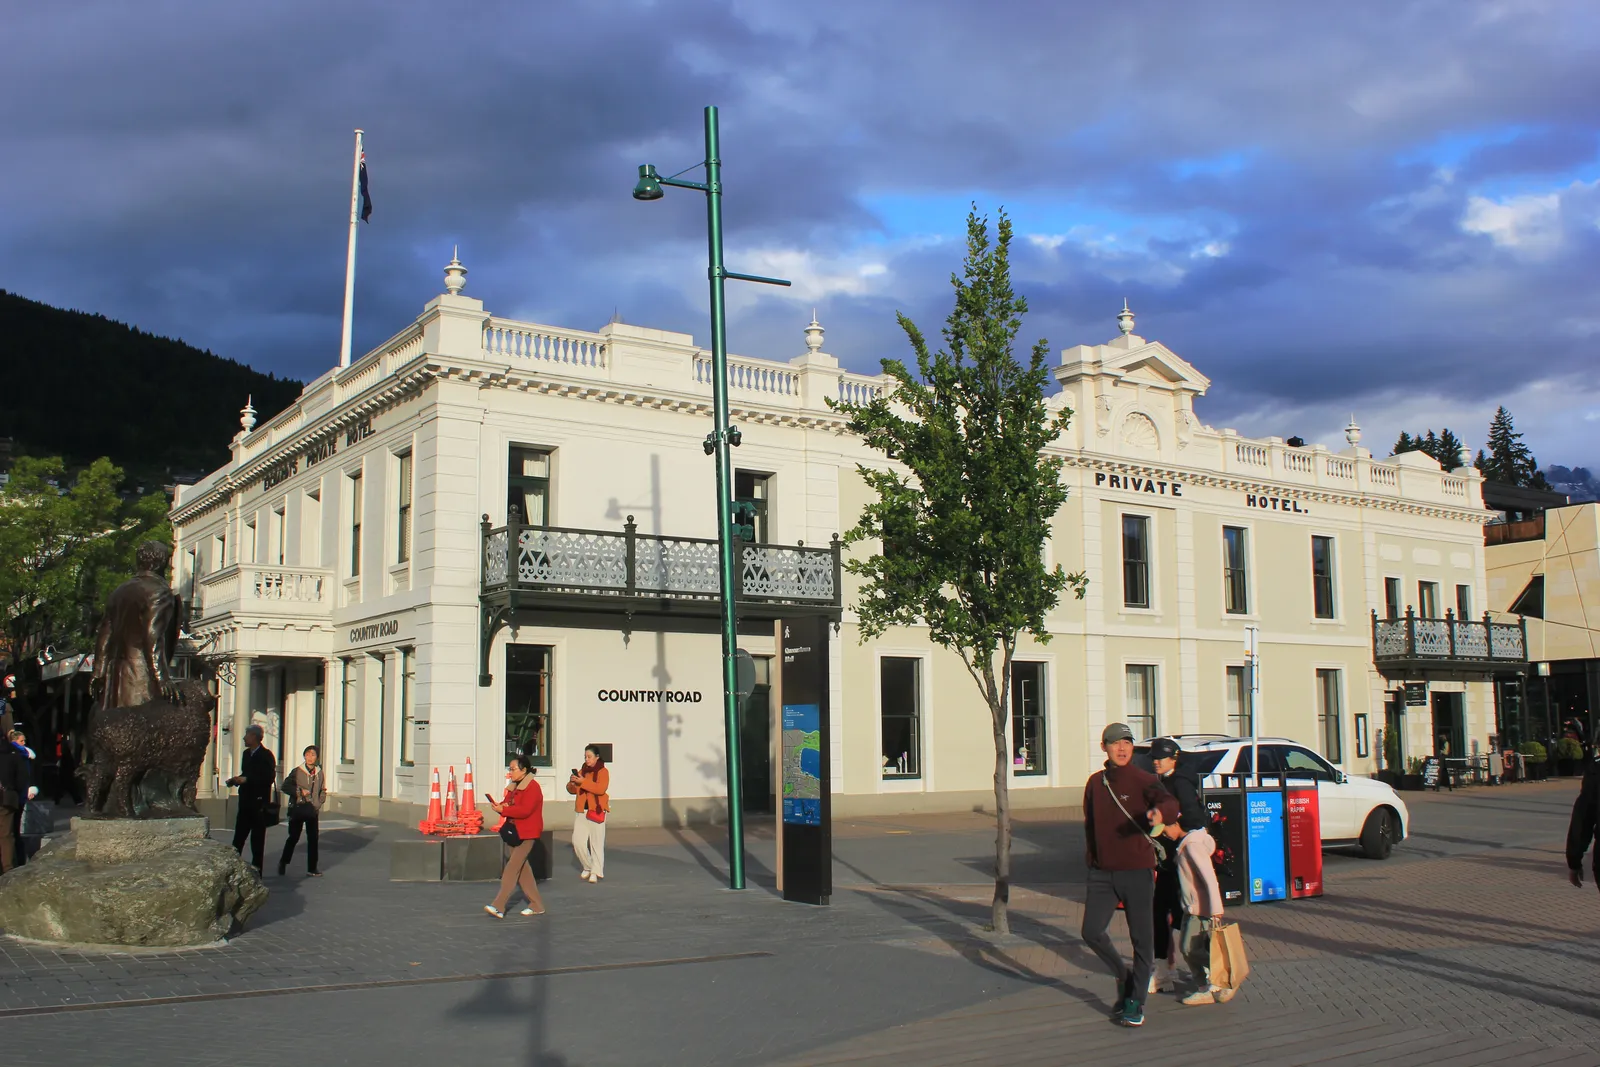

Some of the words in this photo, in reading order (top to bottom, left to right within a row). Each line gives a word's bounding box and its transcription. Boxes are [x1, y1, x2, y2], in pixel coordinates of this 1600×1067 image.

[1095, 472, 1183, 497] PRIVATE
[1246, 493, 1309, 514] HOTEL.
[350, 623, 380, 643] COUNTRY
[380, 619, 399, 637] ROAD
[598, 689, 663, 703] COUNTRY
[666, 691, 702, 703] ROAD
